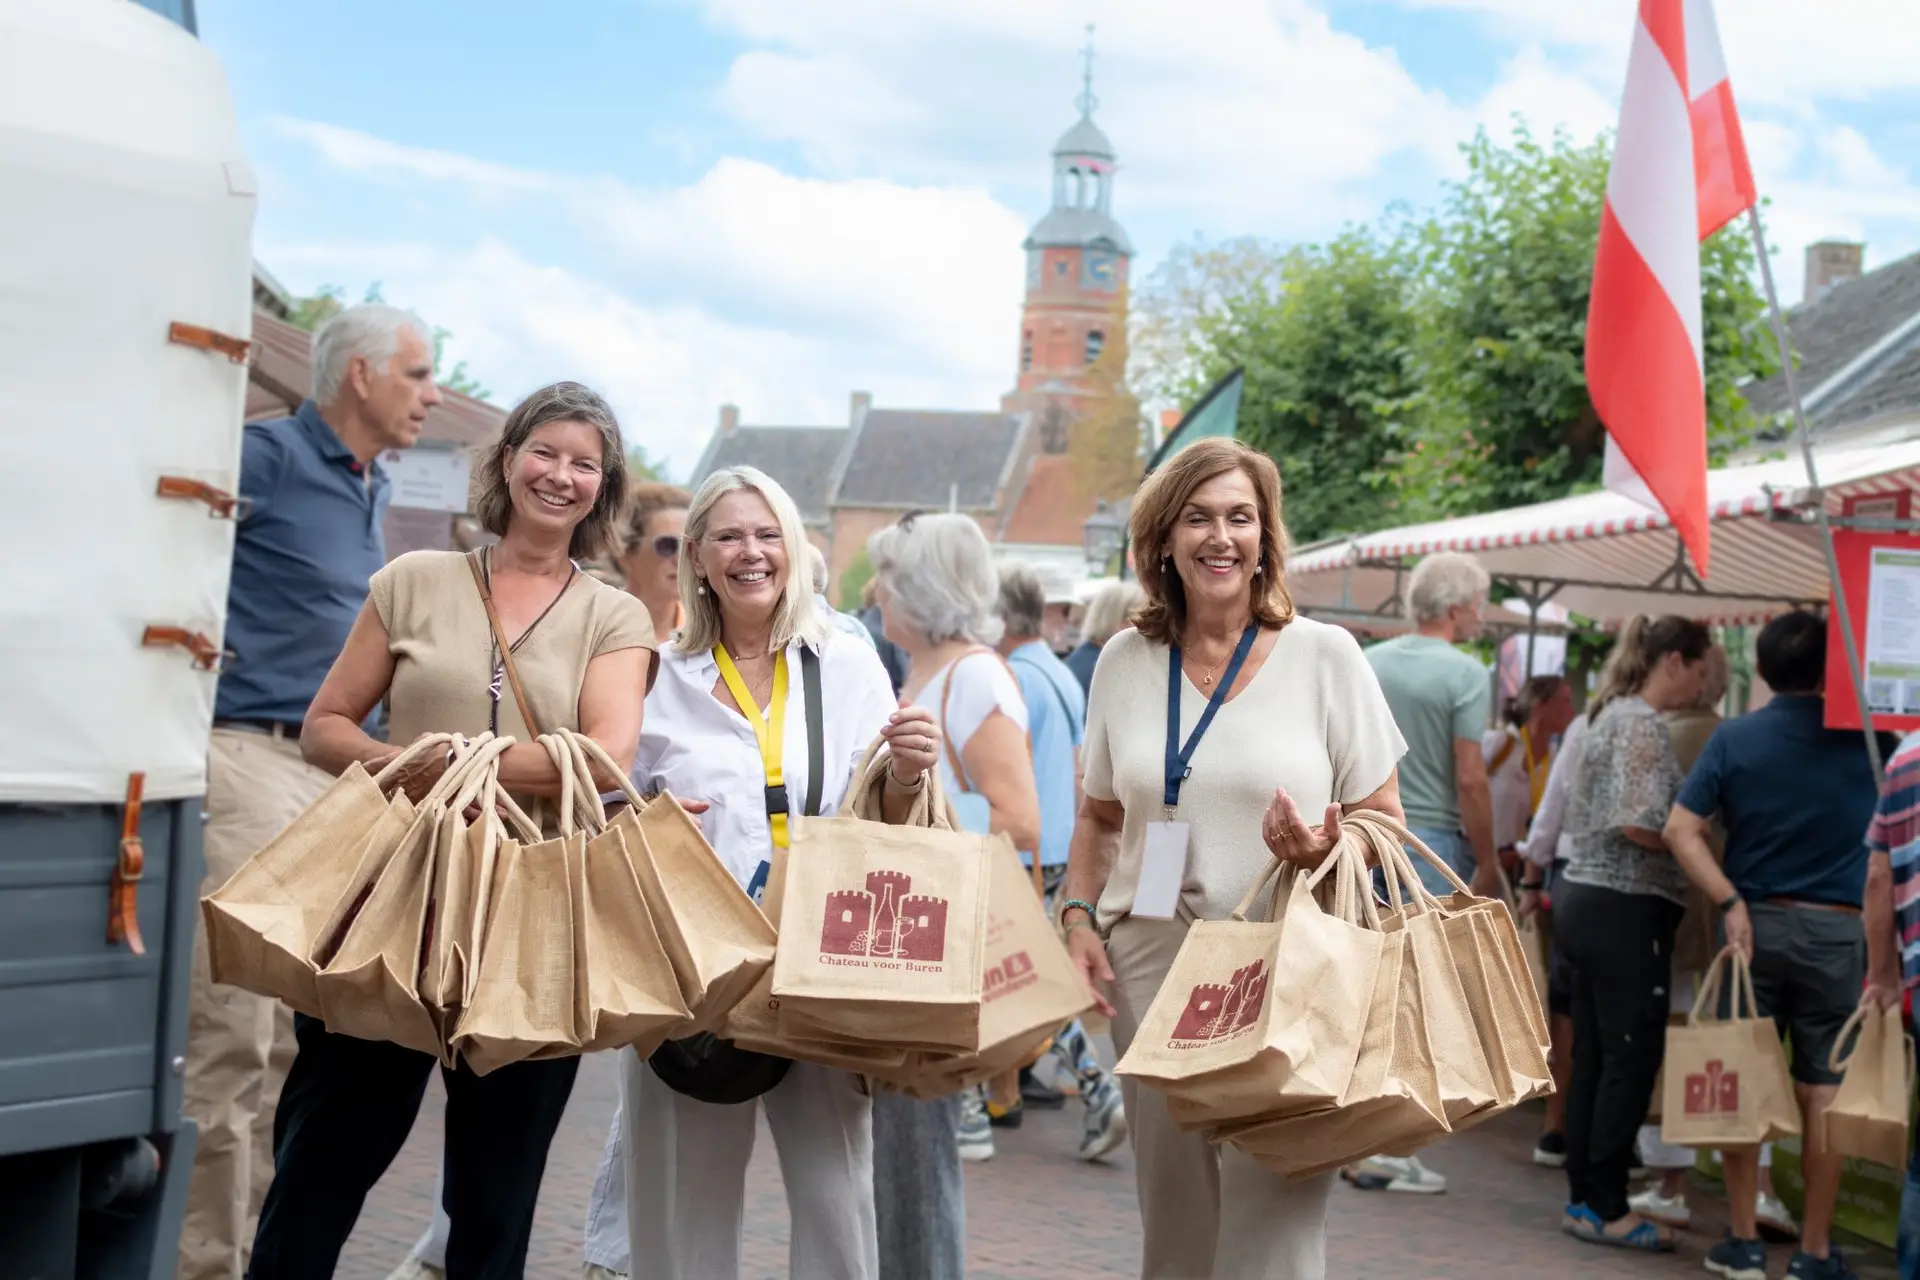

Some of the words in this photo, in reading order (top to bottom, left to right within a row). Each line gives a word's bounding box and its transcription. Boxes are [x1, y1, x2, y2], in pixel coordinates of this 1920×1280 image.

[819, 955, 868, 968] Chateau
[873, 961, 901, 970] voor
[905, 962, 943, 973] Buren
[1167, 1040, 1207, 1050] Chateau
